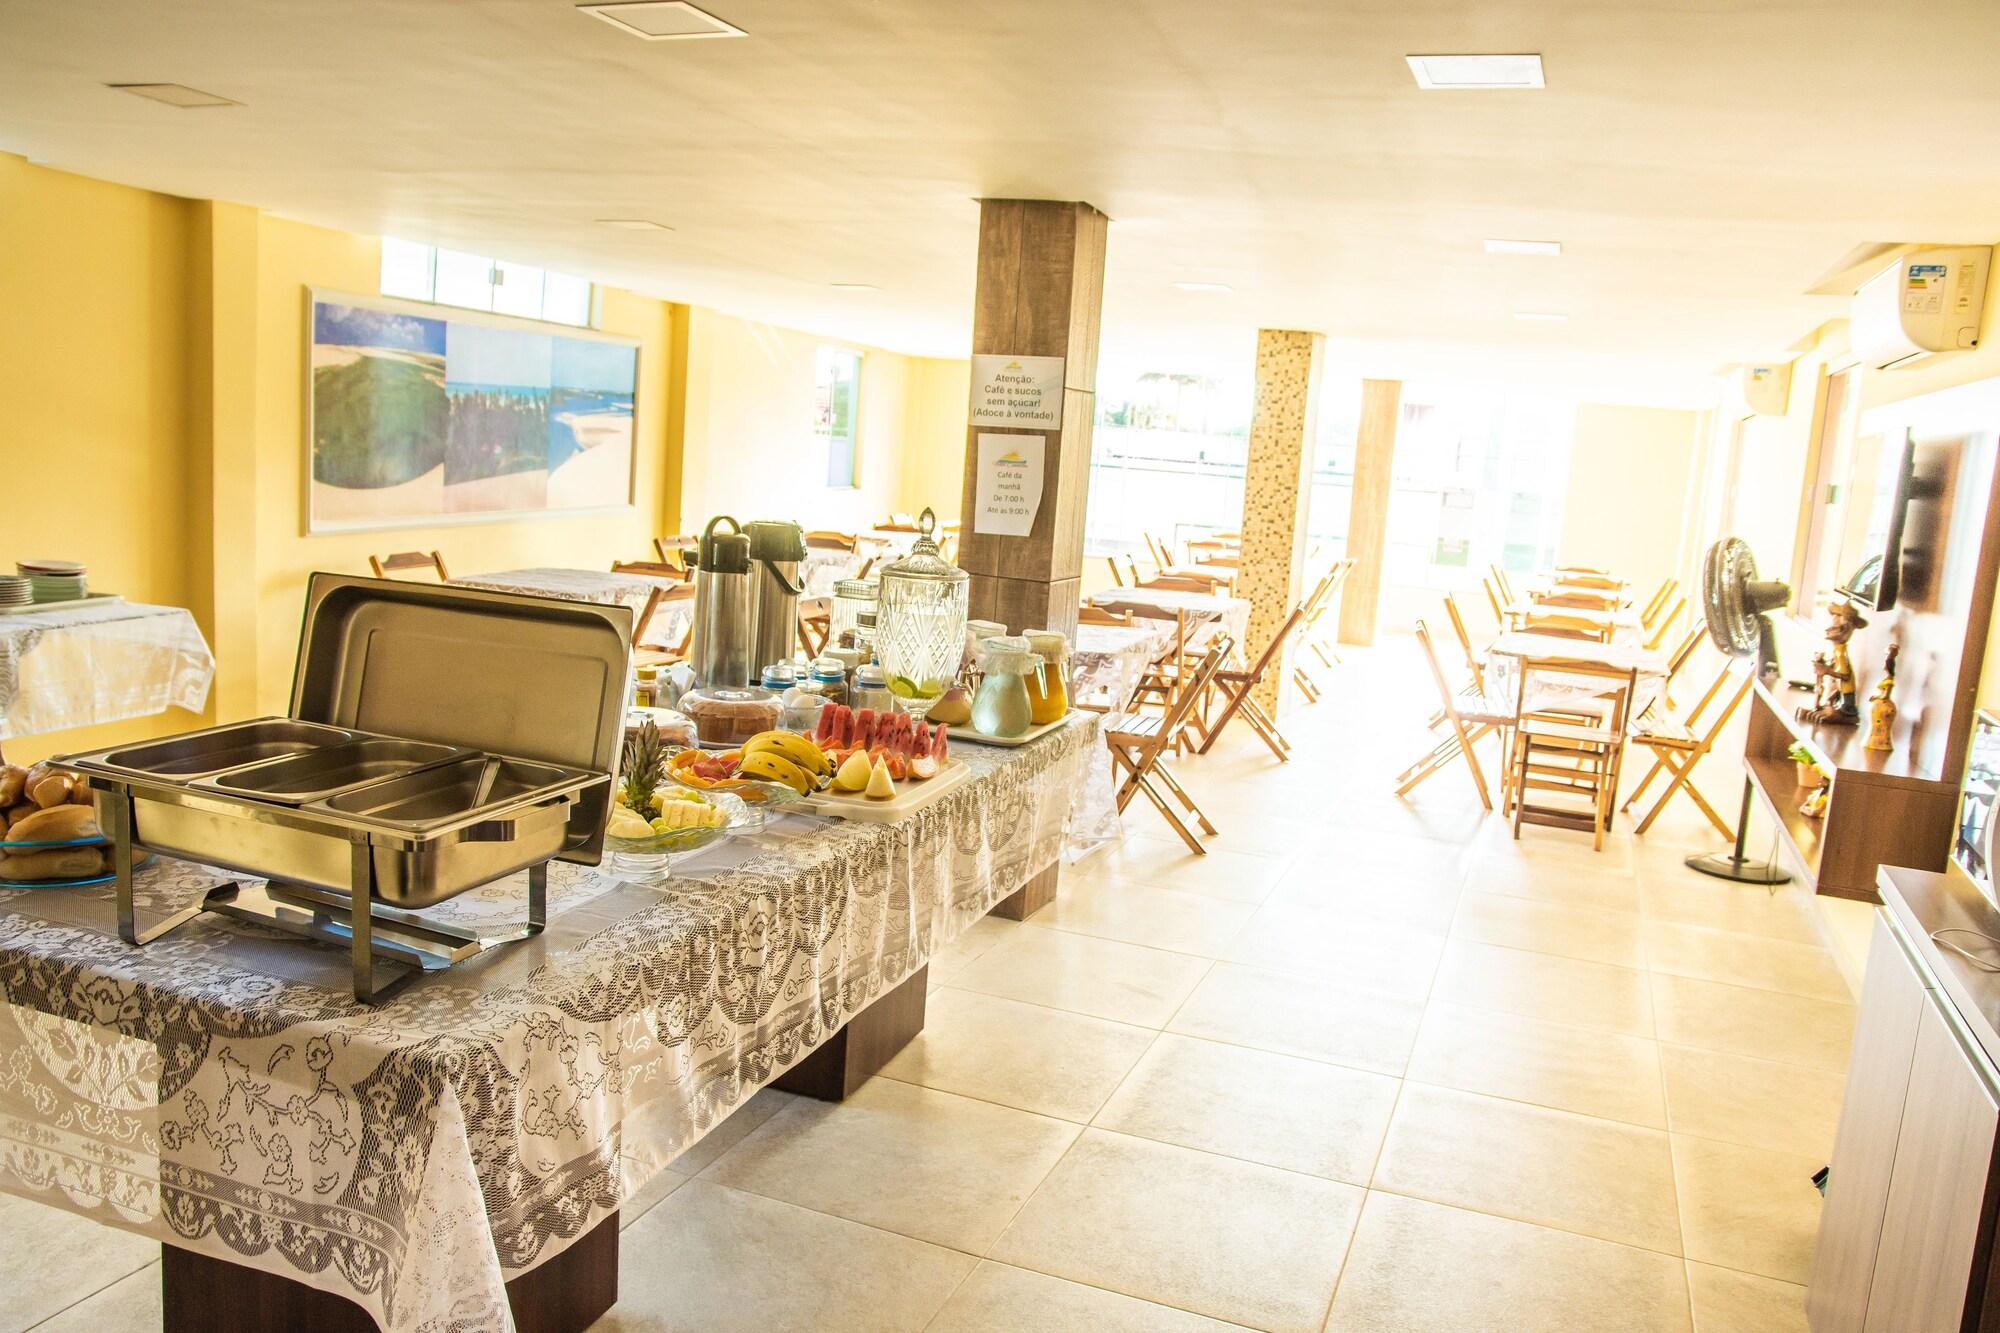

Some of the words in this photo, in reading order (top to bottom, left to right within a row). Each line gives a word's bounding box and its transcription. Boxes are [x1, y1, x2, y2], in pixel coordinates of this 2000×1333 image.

[995, 374, 1035, 384] Atenção:
[984, 385, 1004, 394] Café
[987, 398, 1005, 406] sem
[973, 408, 1004, 417] (Adoce
[1015, 411, 1054, 420] vontade)
